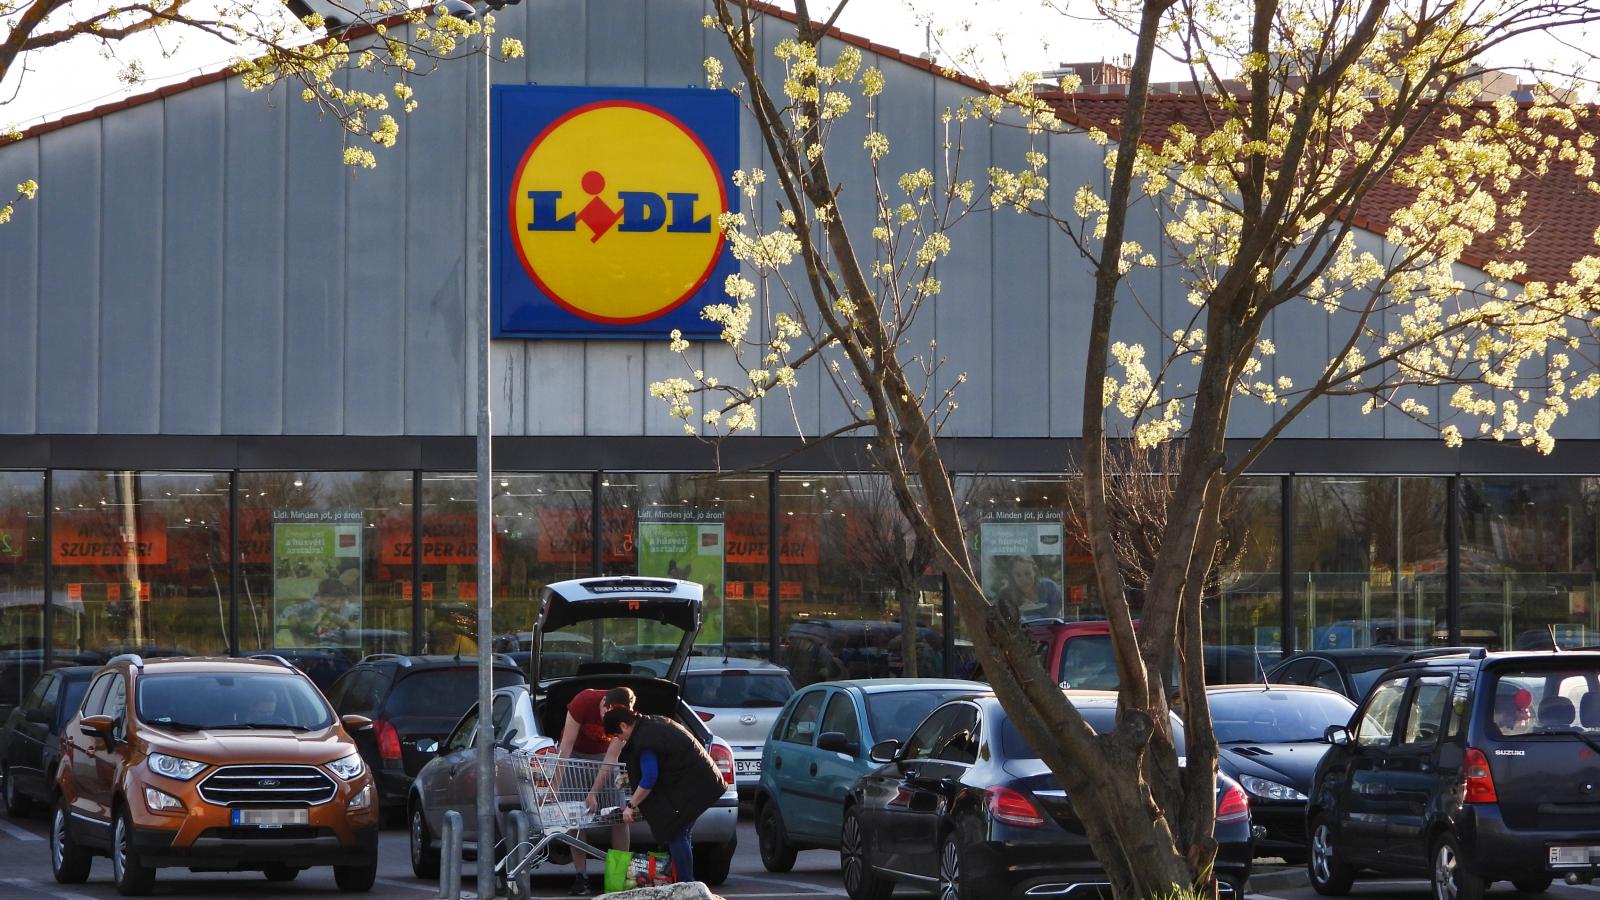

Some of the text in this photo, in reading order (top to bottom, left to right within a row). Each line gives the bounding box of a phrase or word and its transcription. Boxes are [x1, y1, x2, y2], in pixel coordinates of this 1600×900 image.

[273, 510, 289, 519] Lidl.
[290, 510, 319, 519] Minden
[654, 510, 682, 519] Minden
[696, 510, 704, 520] jó
[995, 511, 1022, 519] Minden
[1036, 511, 1044, 520] jó
[60, 542, 122, 557] SZUPER
[393, 542, 453, 557] SZPER
[726, 541, 769, 557] ZUPE
